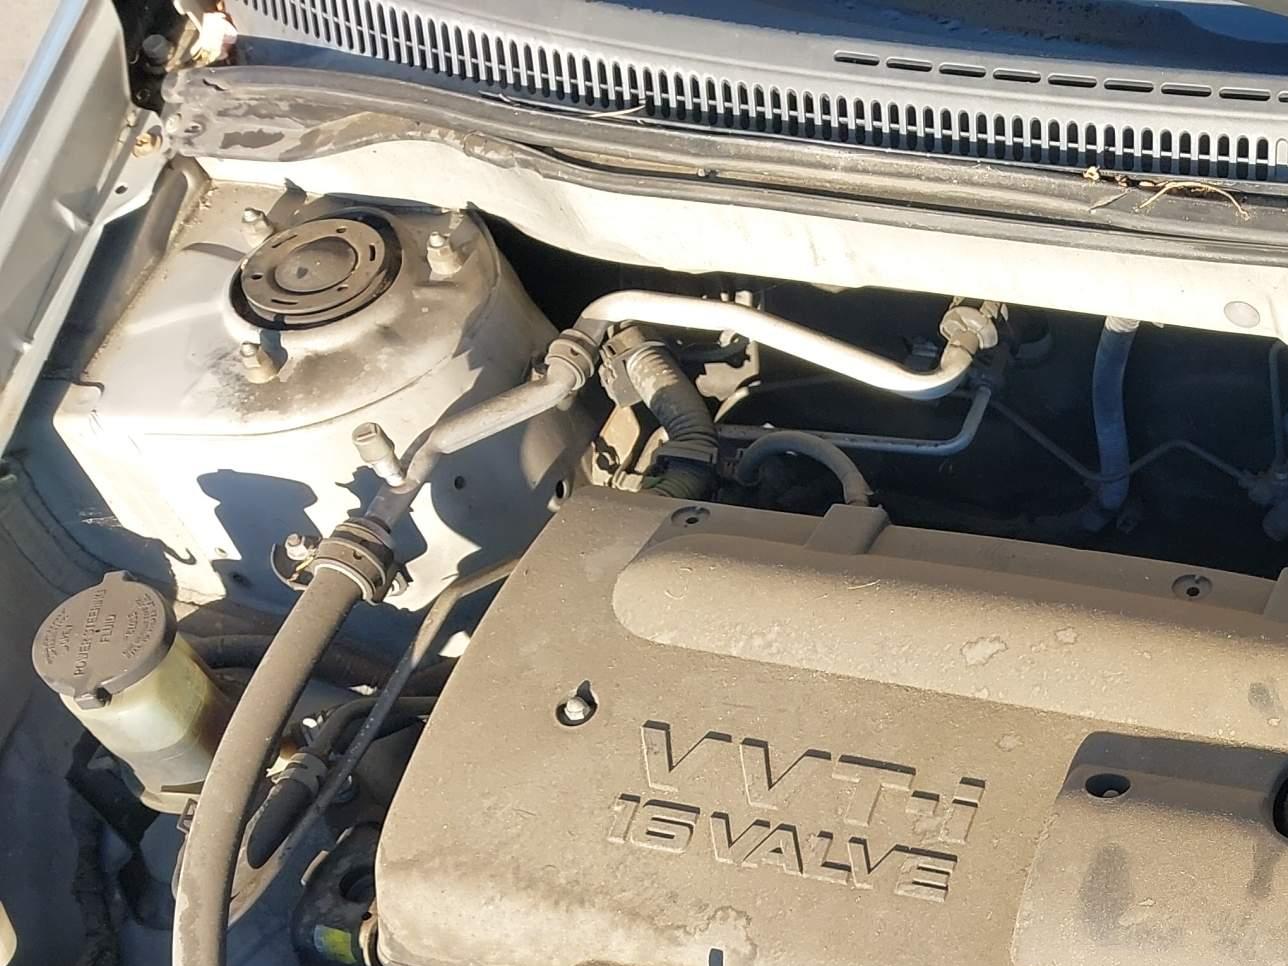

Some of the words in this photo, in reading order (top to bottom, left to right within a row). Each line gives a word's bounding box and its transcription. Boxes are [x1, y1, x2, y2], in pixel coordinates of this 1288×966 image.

[73, 635, 93, 676] POWER
[85, 589, 107, 635] STEERING
[100, 613, 117, 644] FLUID
[607, 792, 701, 854] 16
[710, 811, 958, 904] VALVE
